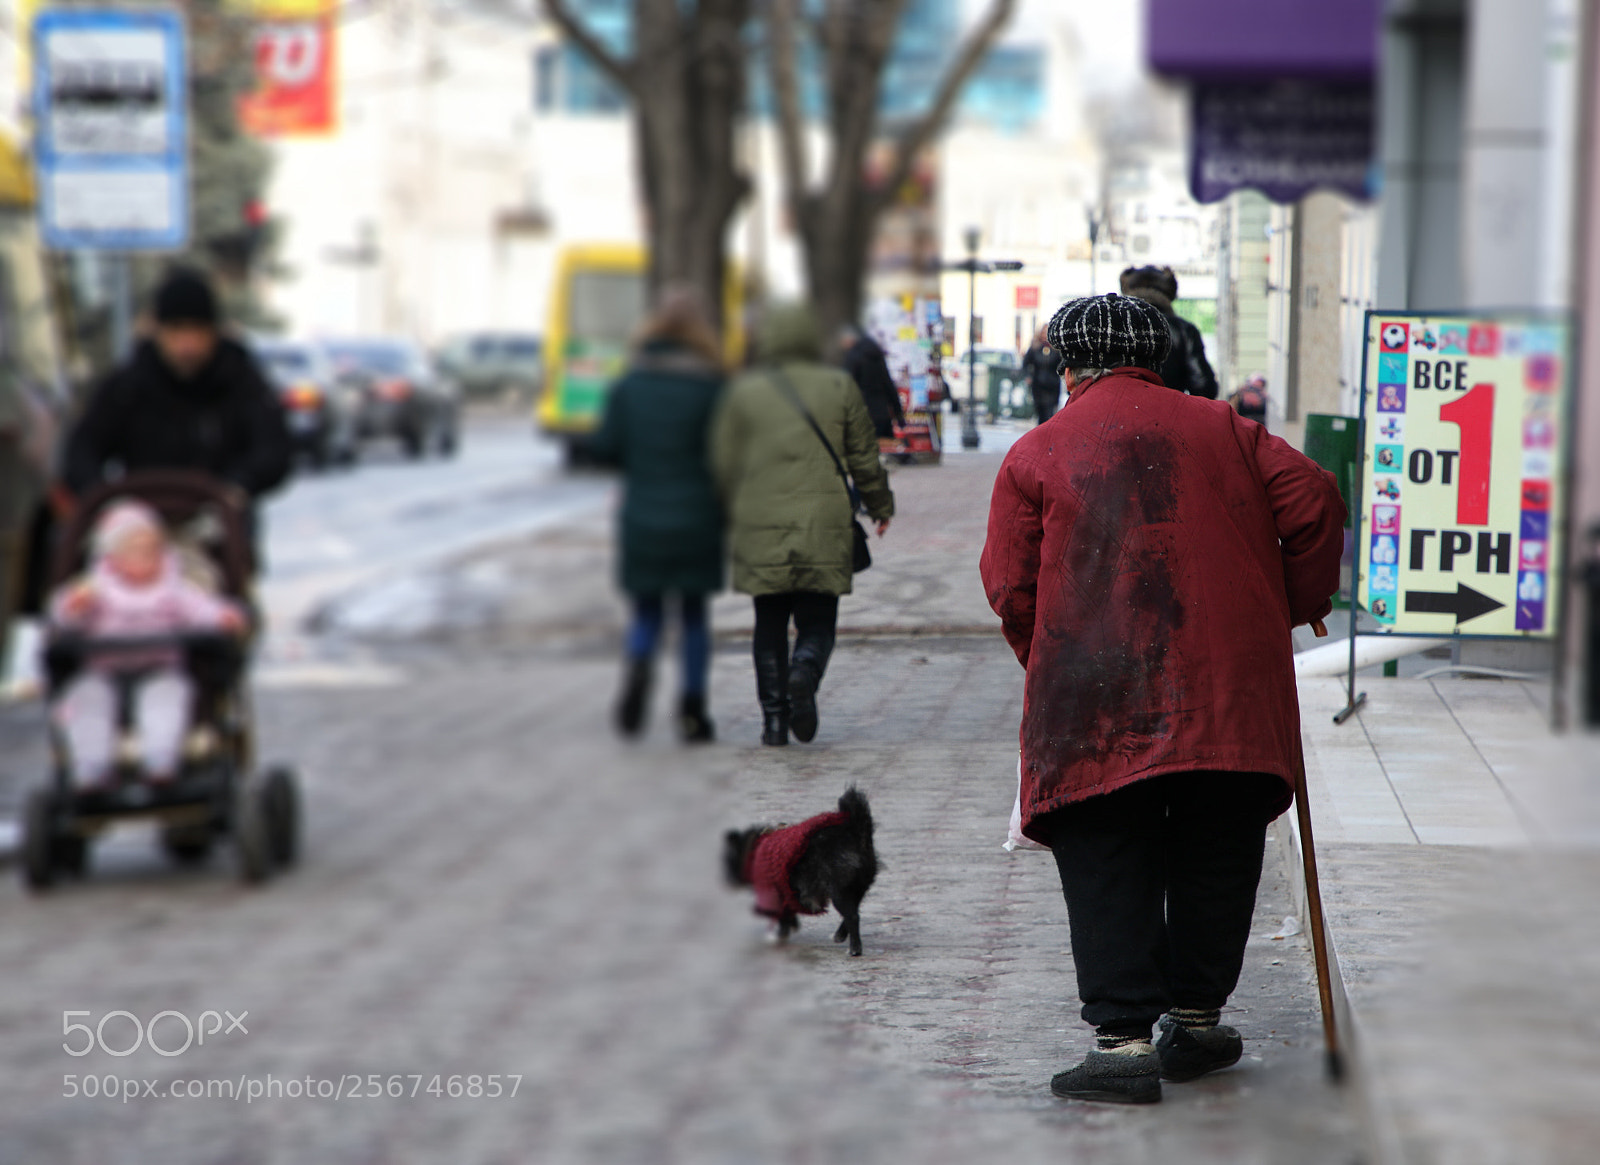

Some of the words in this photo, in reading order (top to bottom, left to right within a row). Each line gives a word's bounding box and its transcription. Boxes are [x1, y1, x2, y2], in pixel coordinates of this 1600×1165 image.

[1413, 361, 1467, 391] ВСЕ
[1409, 449, 1459, 485] ОТ
[1439, 383, 1495, 525] 1
[1409, 528, 1511, 574] ГРН
